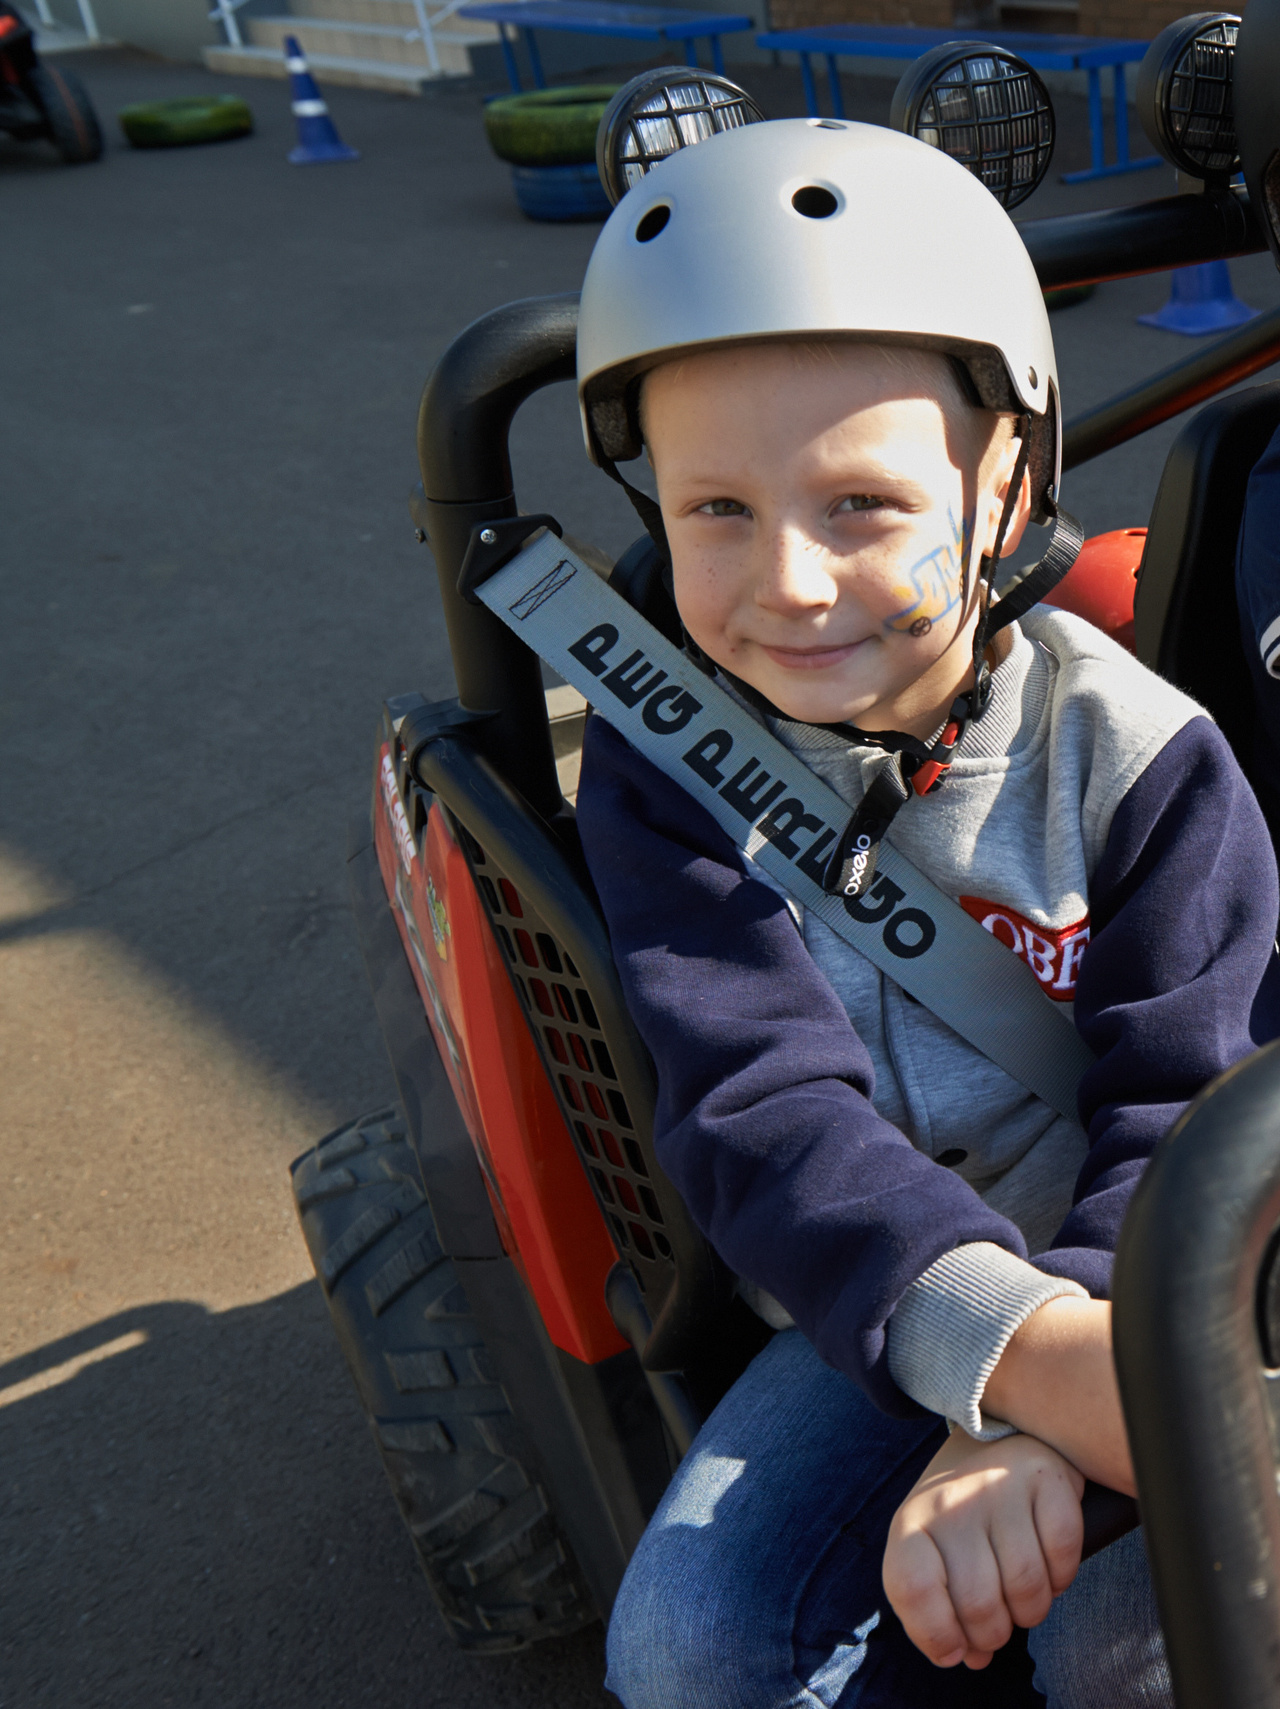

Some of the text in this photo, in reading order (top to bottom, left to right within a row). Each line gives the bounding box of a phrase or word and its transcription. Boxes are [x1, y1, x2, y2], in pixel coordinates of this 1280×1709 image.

[567, 622, 937, 959] PEG PEREGO
[843, 833, 871, 897] oxelo
